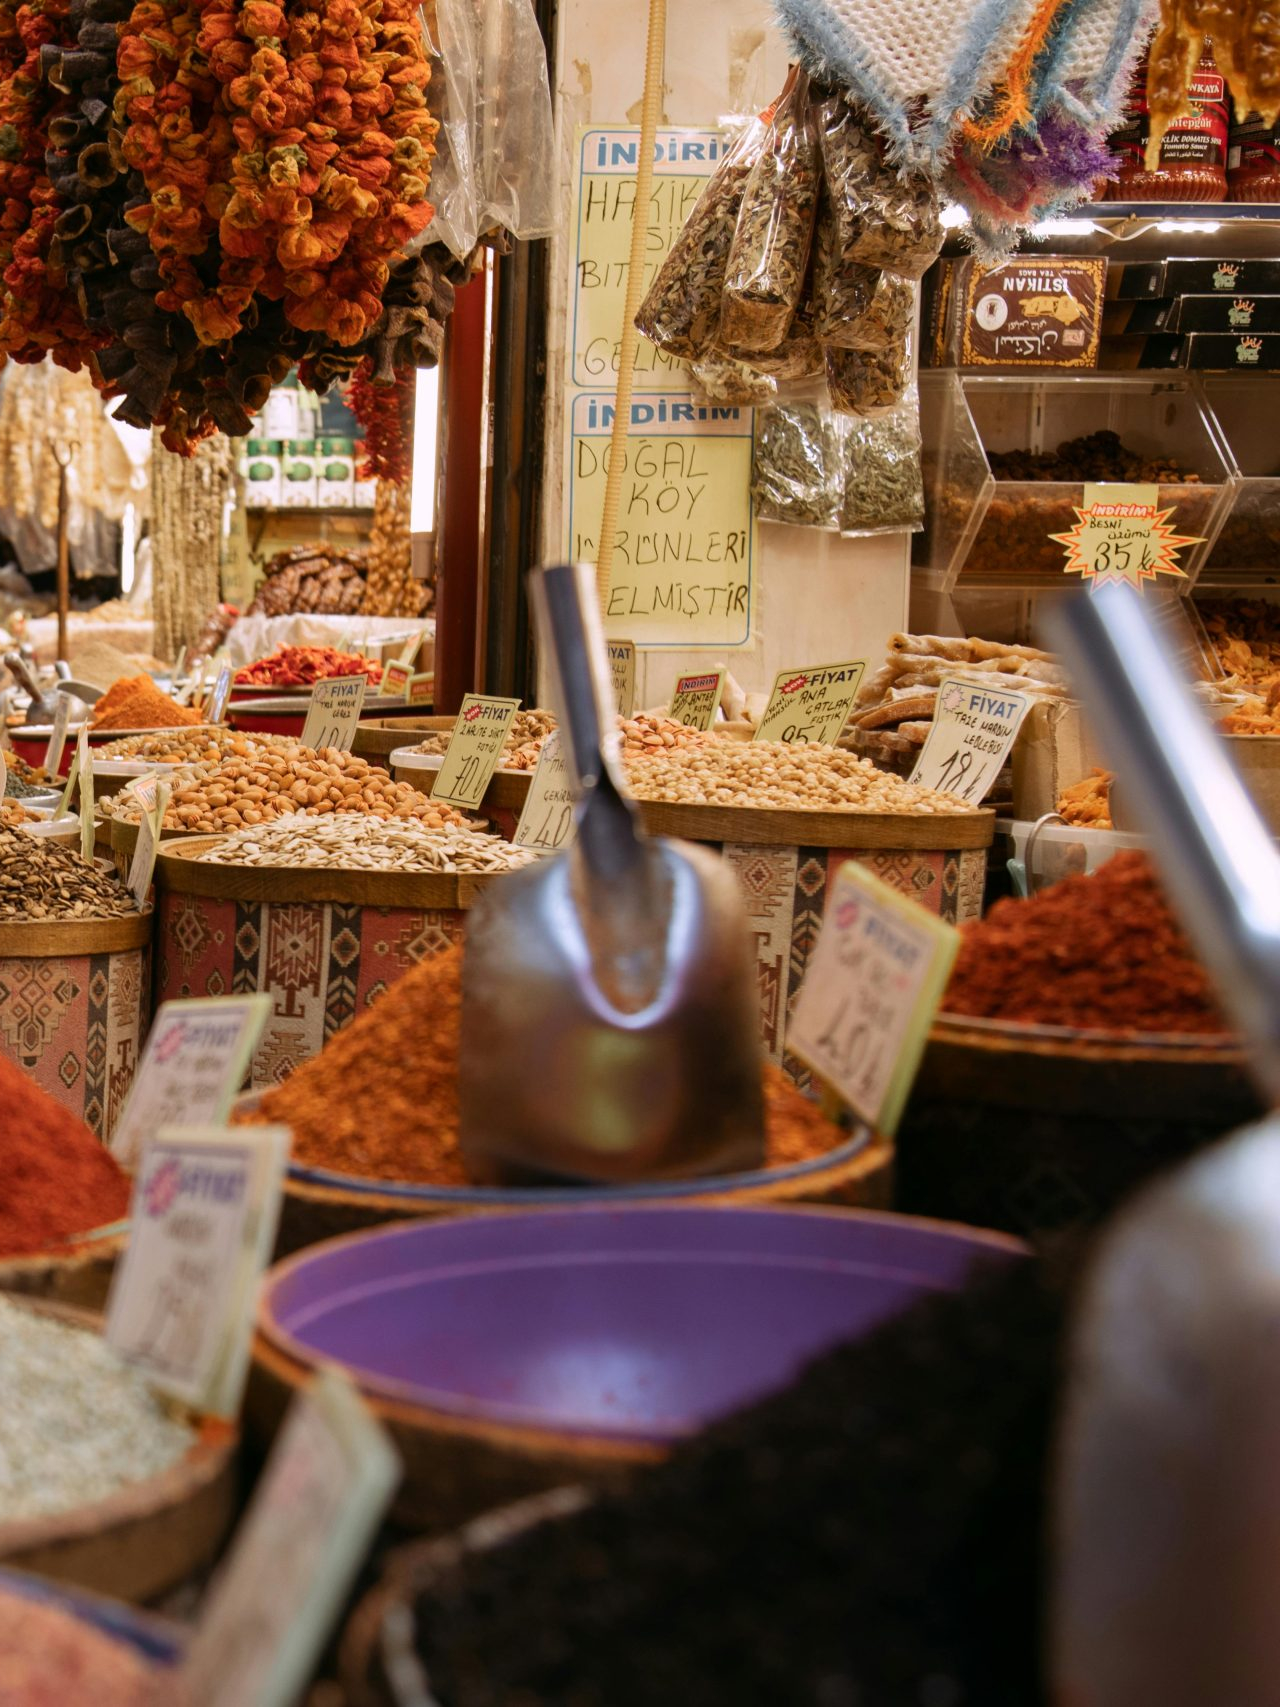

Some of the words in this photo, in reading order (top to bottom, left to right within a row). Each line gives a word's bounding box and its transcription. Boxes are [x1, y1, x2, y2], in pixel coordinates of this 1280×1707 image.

[1003, 276, 1068, 292] ISTIKAN
[1039, 269, 1055, 277] TEA
[628, 481, 706, 520] KÖY
[1090, 503, 1148, 517] İNDİRİM
[1094, 541, 1133, 573] 35
[607, 582, 749, 619] ELMİŞTİR
[810, 669, 858, 686] FİYAT
[331, 684, 361, 697] FİYAT
[799, 686, 828, 705] ANA
[481, 704, 511, 721] FİYAT
[969, 693, 1017, 719] FİYAT
[449, 755, 480, 799] 70
[934, 749, 973, 793] 18
[533, 805, 572, 848] 40
